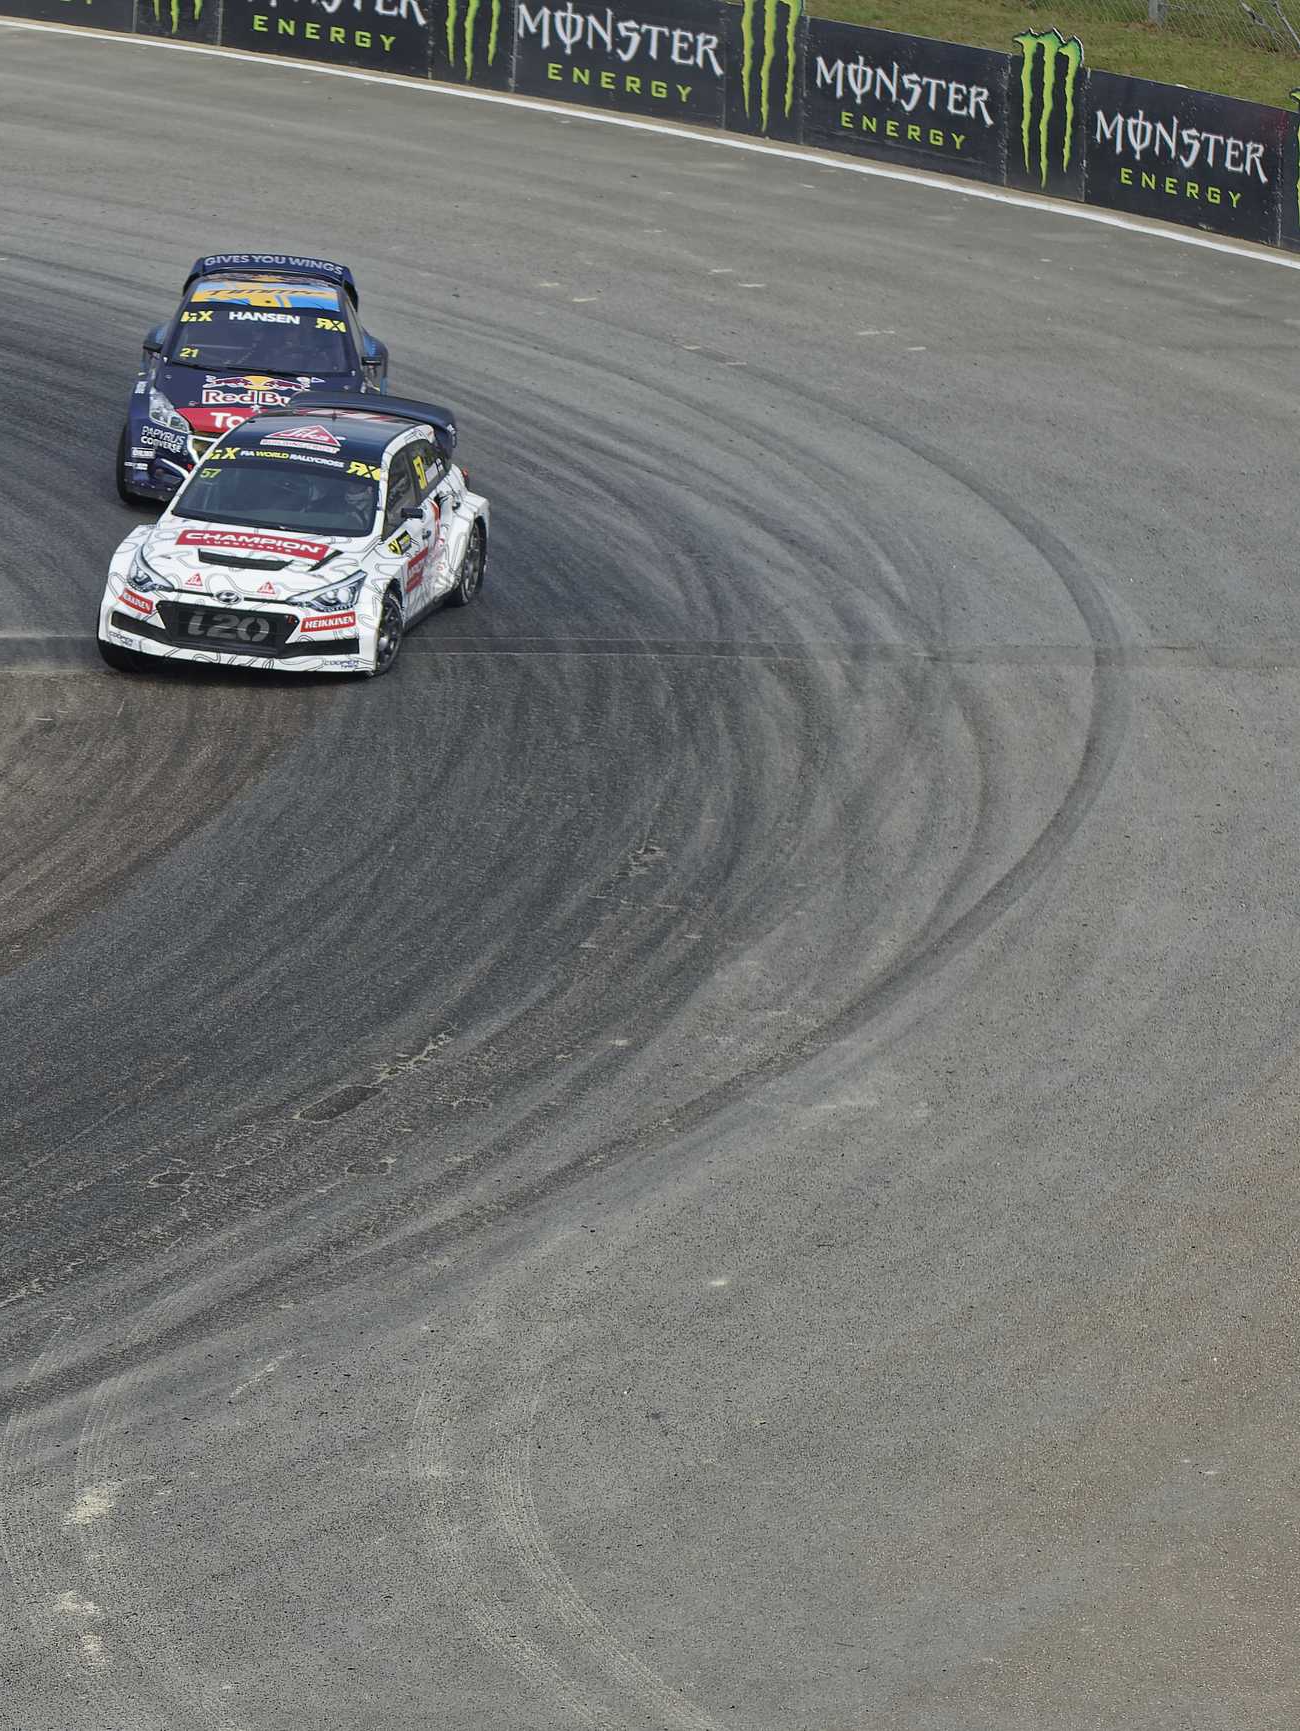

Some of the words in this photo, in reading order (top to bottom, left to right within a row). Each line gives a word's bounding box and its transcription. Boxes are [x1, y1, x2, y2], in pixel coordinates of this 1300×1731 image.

[253, 14, 397, 51] ENERGY
[547, 63, 693, 102] ENERGY
[840, 111, 966, 150] ENERGY
[1120, 167, 1243, 208] ENERGY
[204, 255, 249, 266] GIVES
[251, 255, 286, 264] YOU
[288, 257, 344, 276] WINGS
[229, 311, 301, 325] HANSEN
[180, 348, 200, 358] 21
[202, 390, 256, 404] Red
[260, 391, 292, 407] Bu
[256, 451, 289, 460] WORLD
[290, 453, 345, 469] RALLYCROSS
[200, 468, 222, 478] 57
[185, 533, 322, 553] CHAMPION
